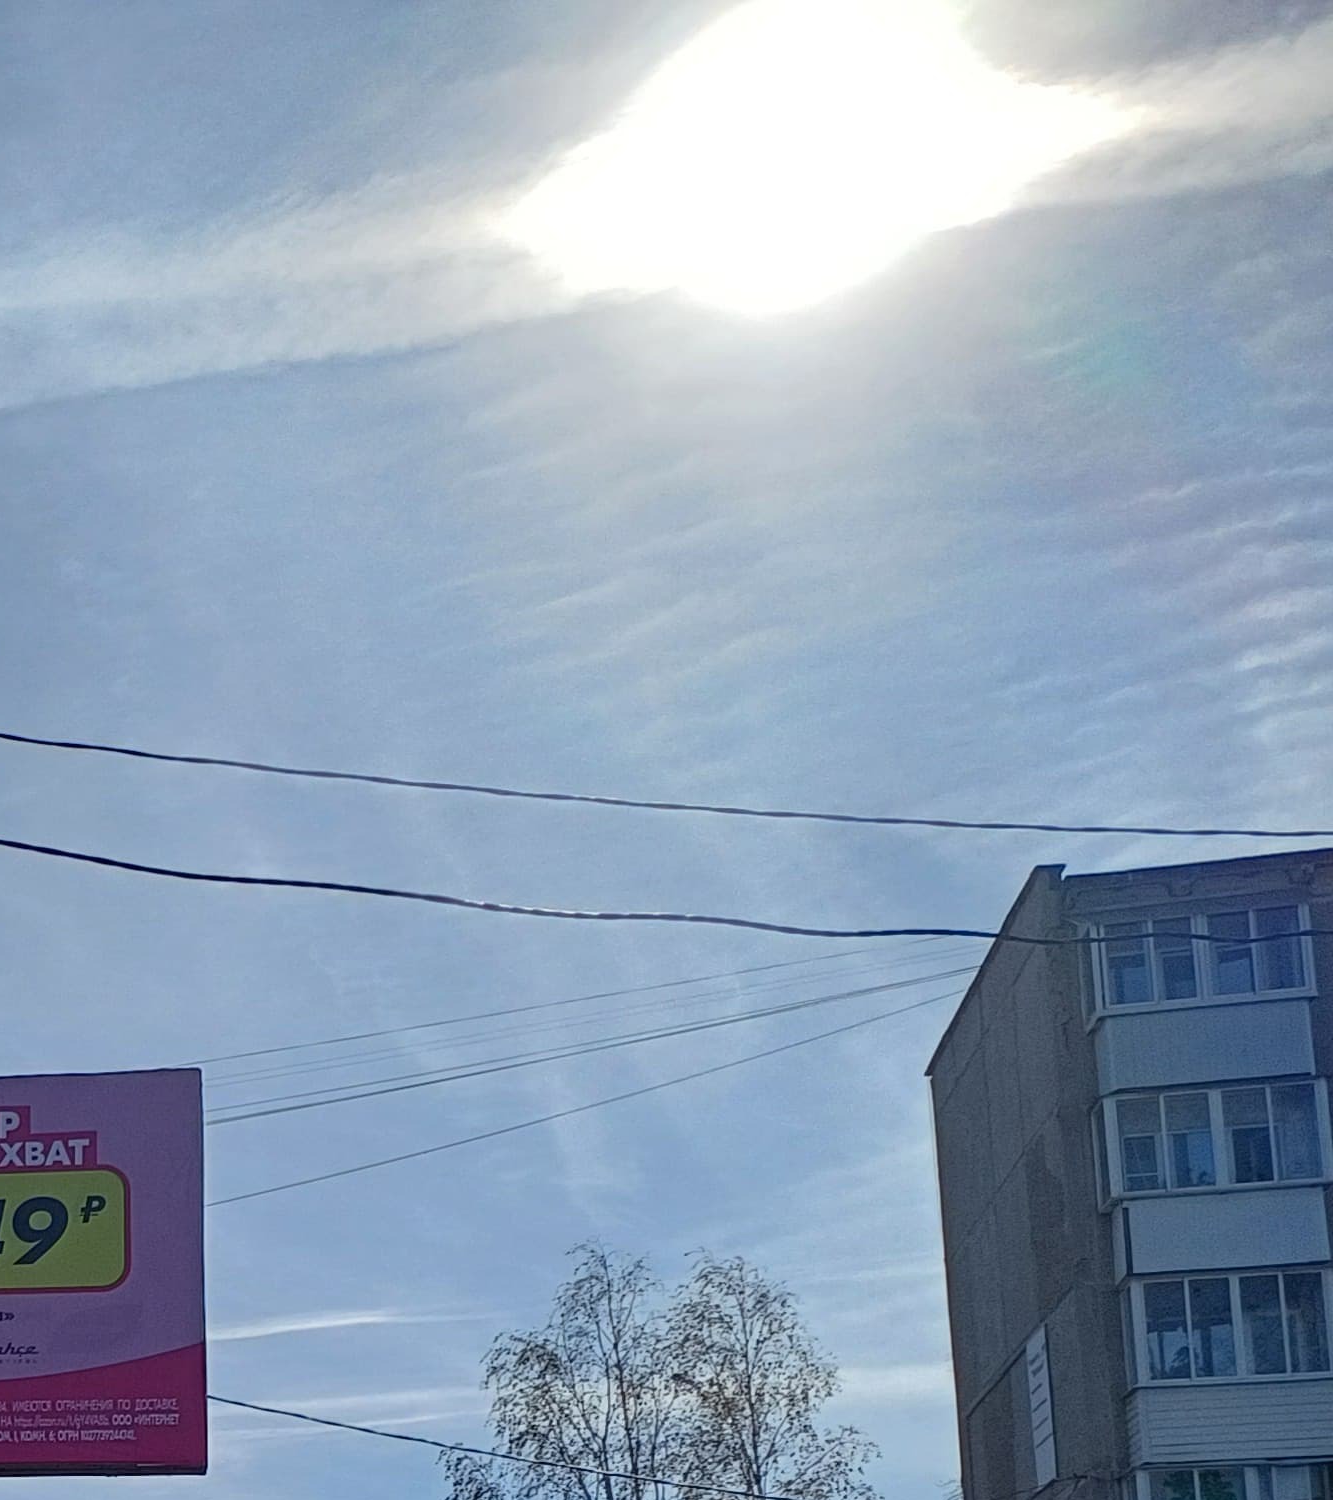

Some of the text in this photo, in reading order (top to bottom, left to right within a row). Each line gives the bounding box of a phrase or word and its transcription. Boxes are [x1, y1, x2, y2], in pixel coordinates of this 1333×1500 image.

[117, 1399, 131, 1411] ПО
[0, 1415, 13, 1427] НА
[111, 1413, 133, 1426] ООО
